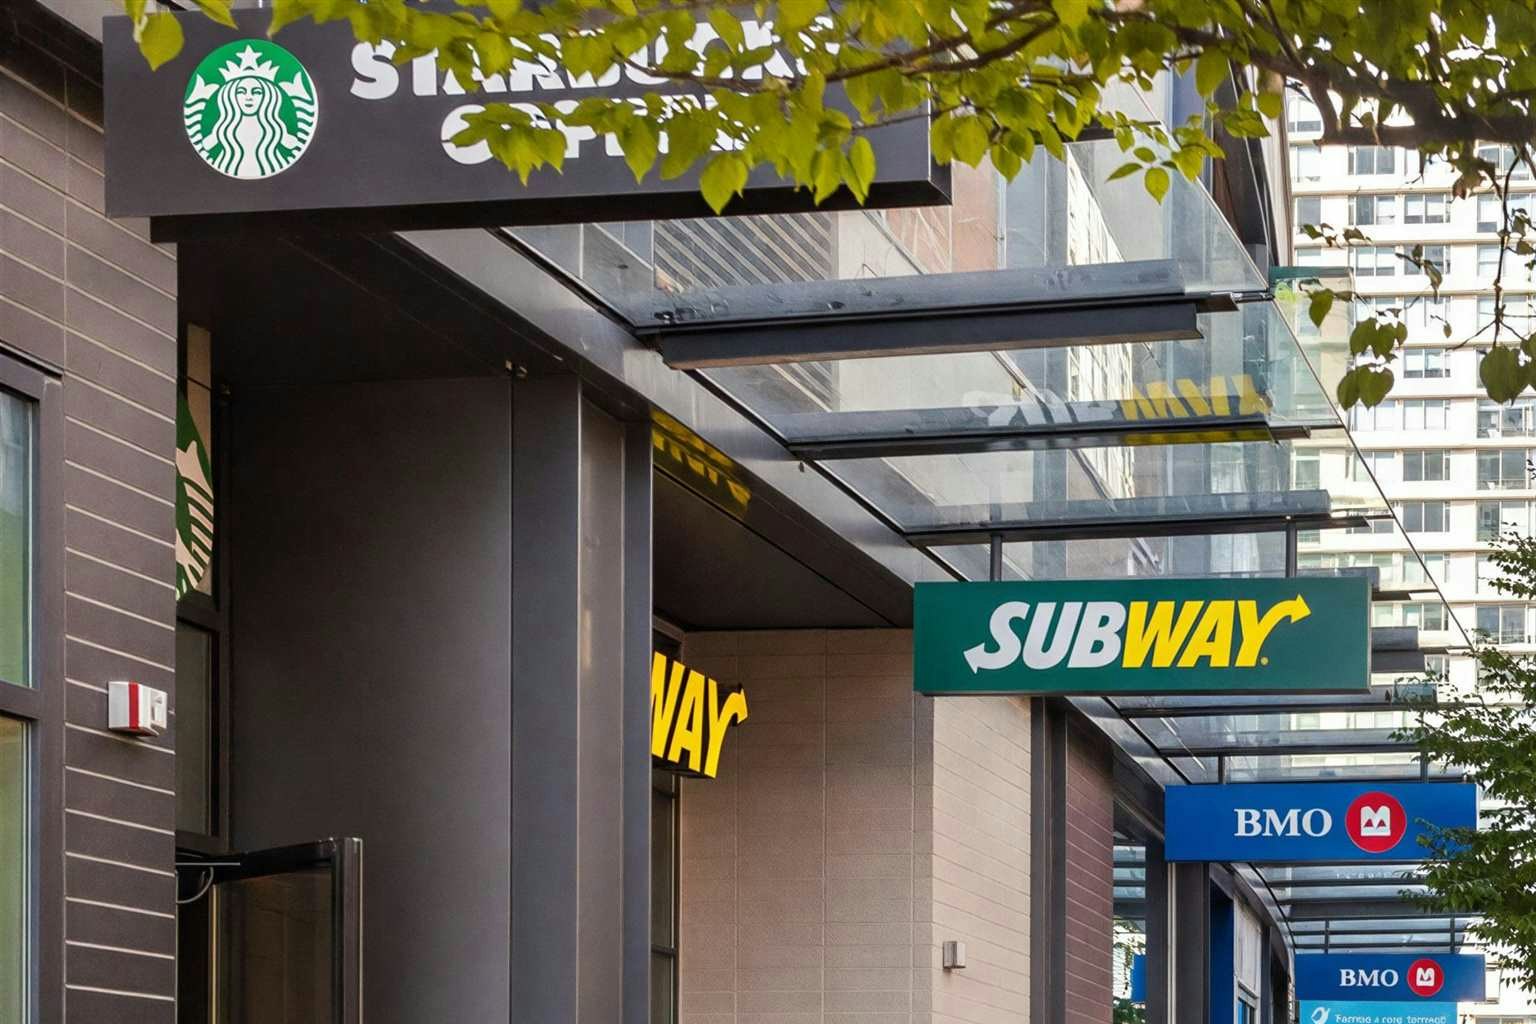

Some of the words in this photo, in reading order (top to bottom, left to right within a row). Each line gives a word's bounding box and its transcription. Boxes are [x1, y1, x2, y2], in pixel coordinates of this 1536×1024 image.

[963, 594, 1312, 674] SUBWAY
[1234, 808, 1333, 837] BMO
[1339, 968, 1399, 988] BMO
